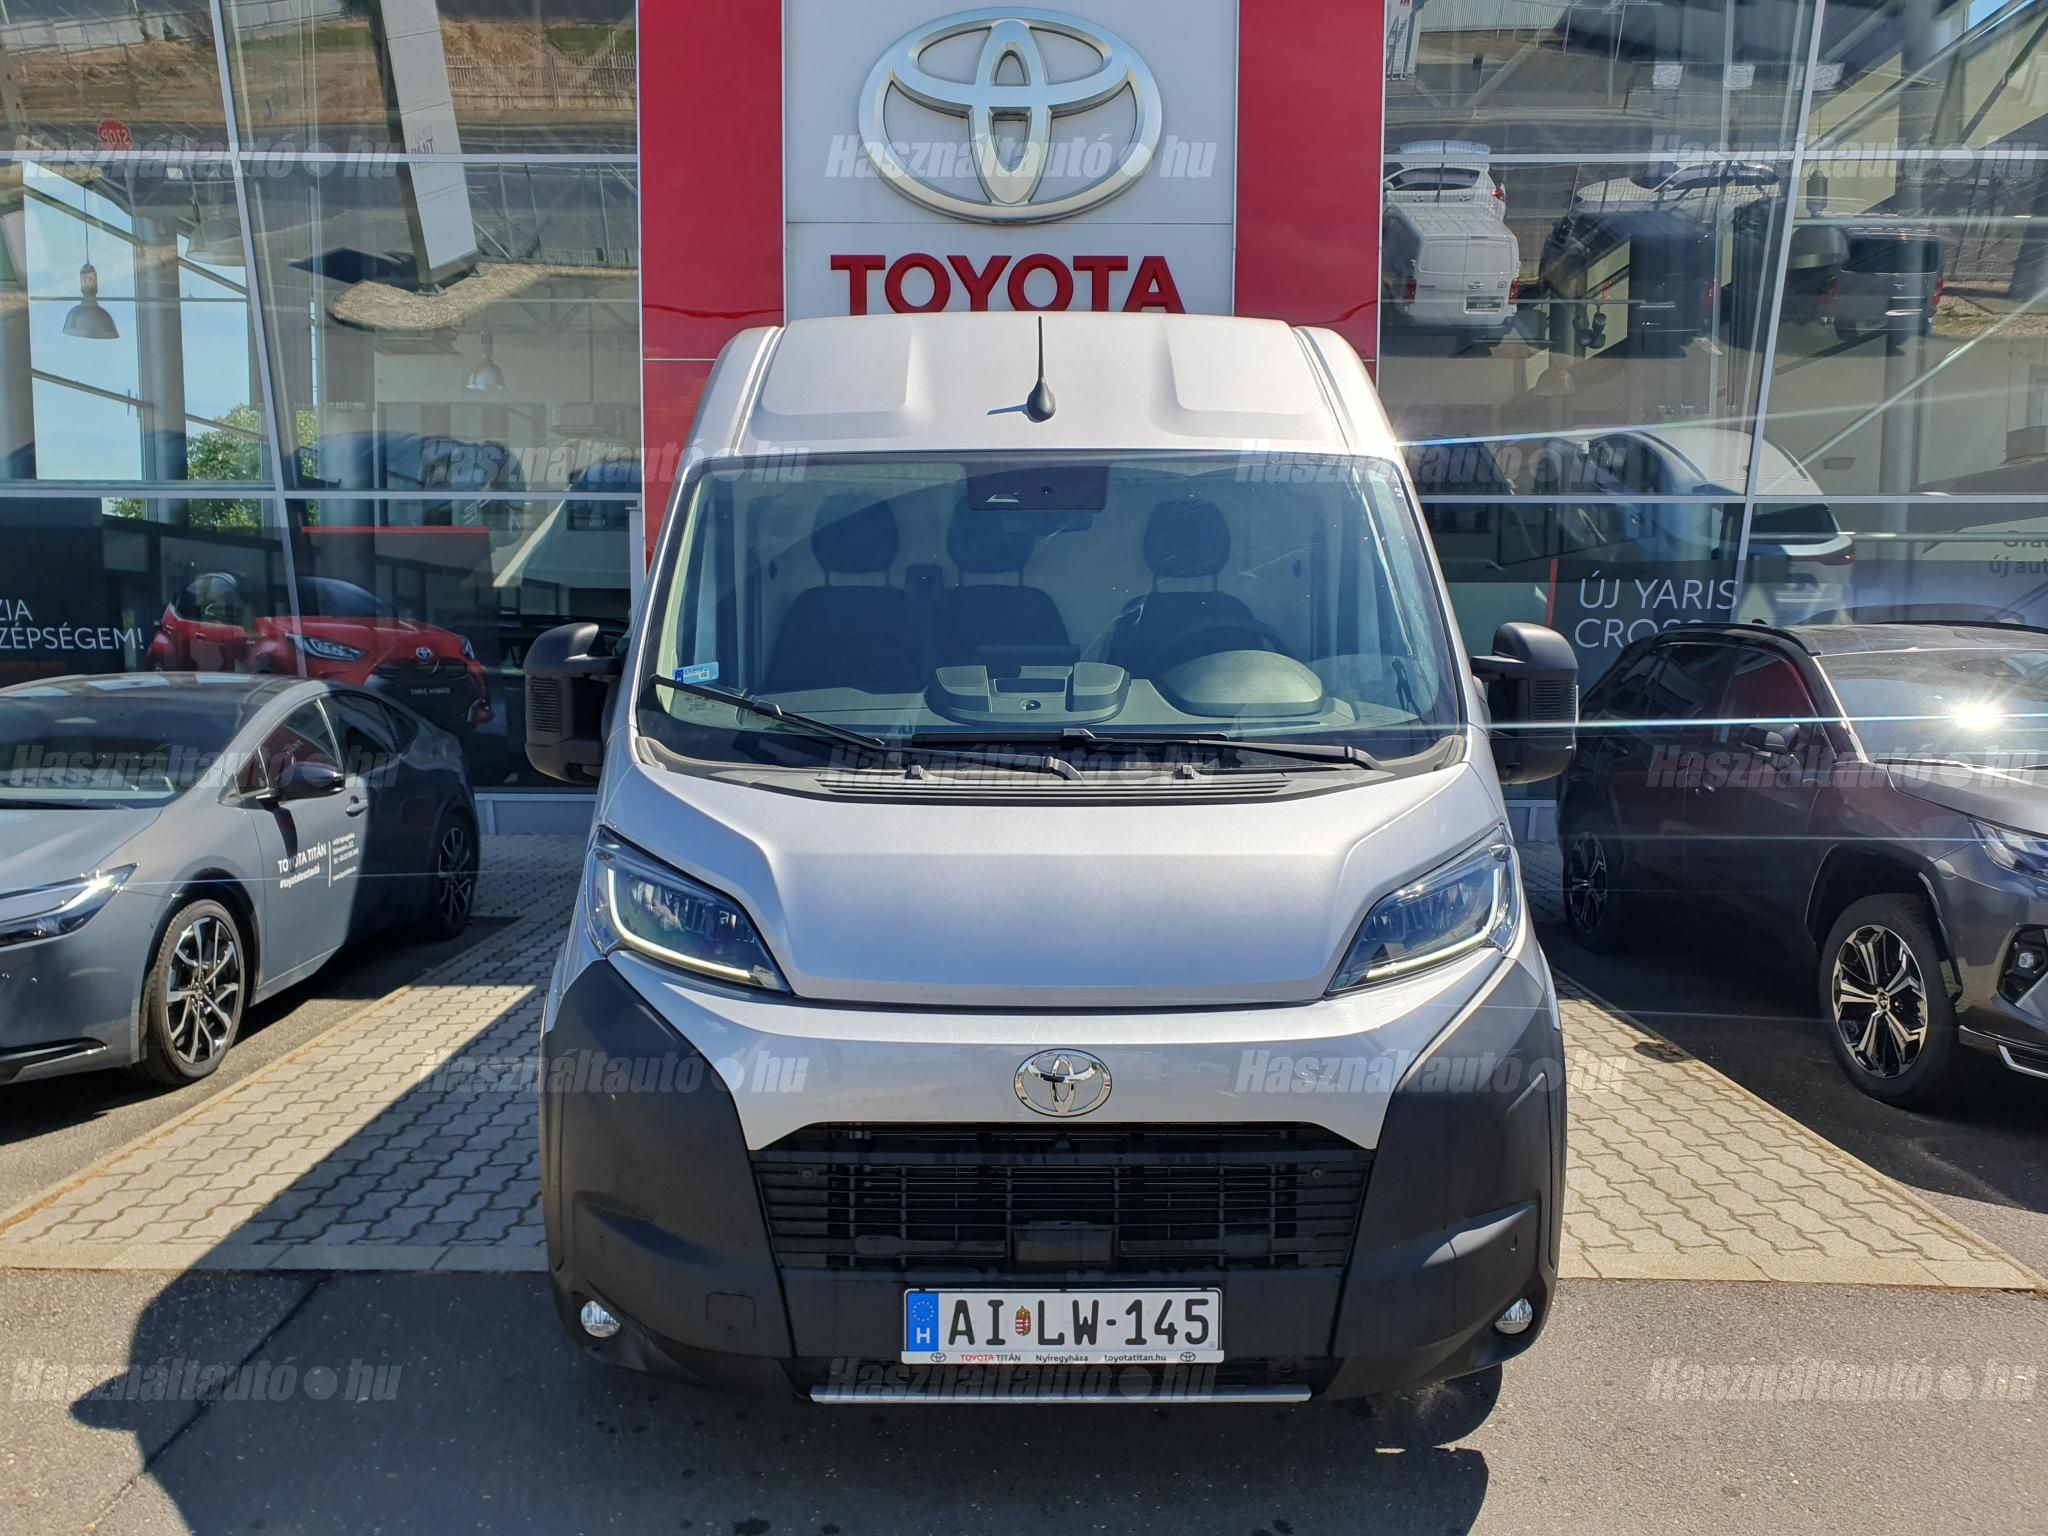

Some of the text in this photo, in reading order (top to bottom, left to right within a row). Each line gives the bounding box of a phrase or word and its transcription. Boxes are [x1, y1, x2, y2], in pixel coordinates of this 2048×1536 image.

[829, 252, 1187, 317] TOYOTA
[1579, 570, 1739, 609] ÚJ YARIS
[1574, 618, 1705, 648] CRO
[278, 851, 307, 874] TOYOTA
[306, 841, 327, 862] TITÁN
[915, 1327, 931, 1345] H
[960, 1352, 1167, 1363] TOYOTA TITÁN Nyíregyháza toyotatitan.hu
